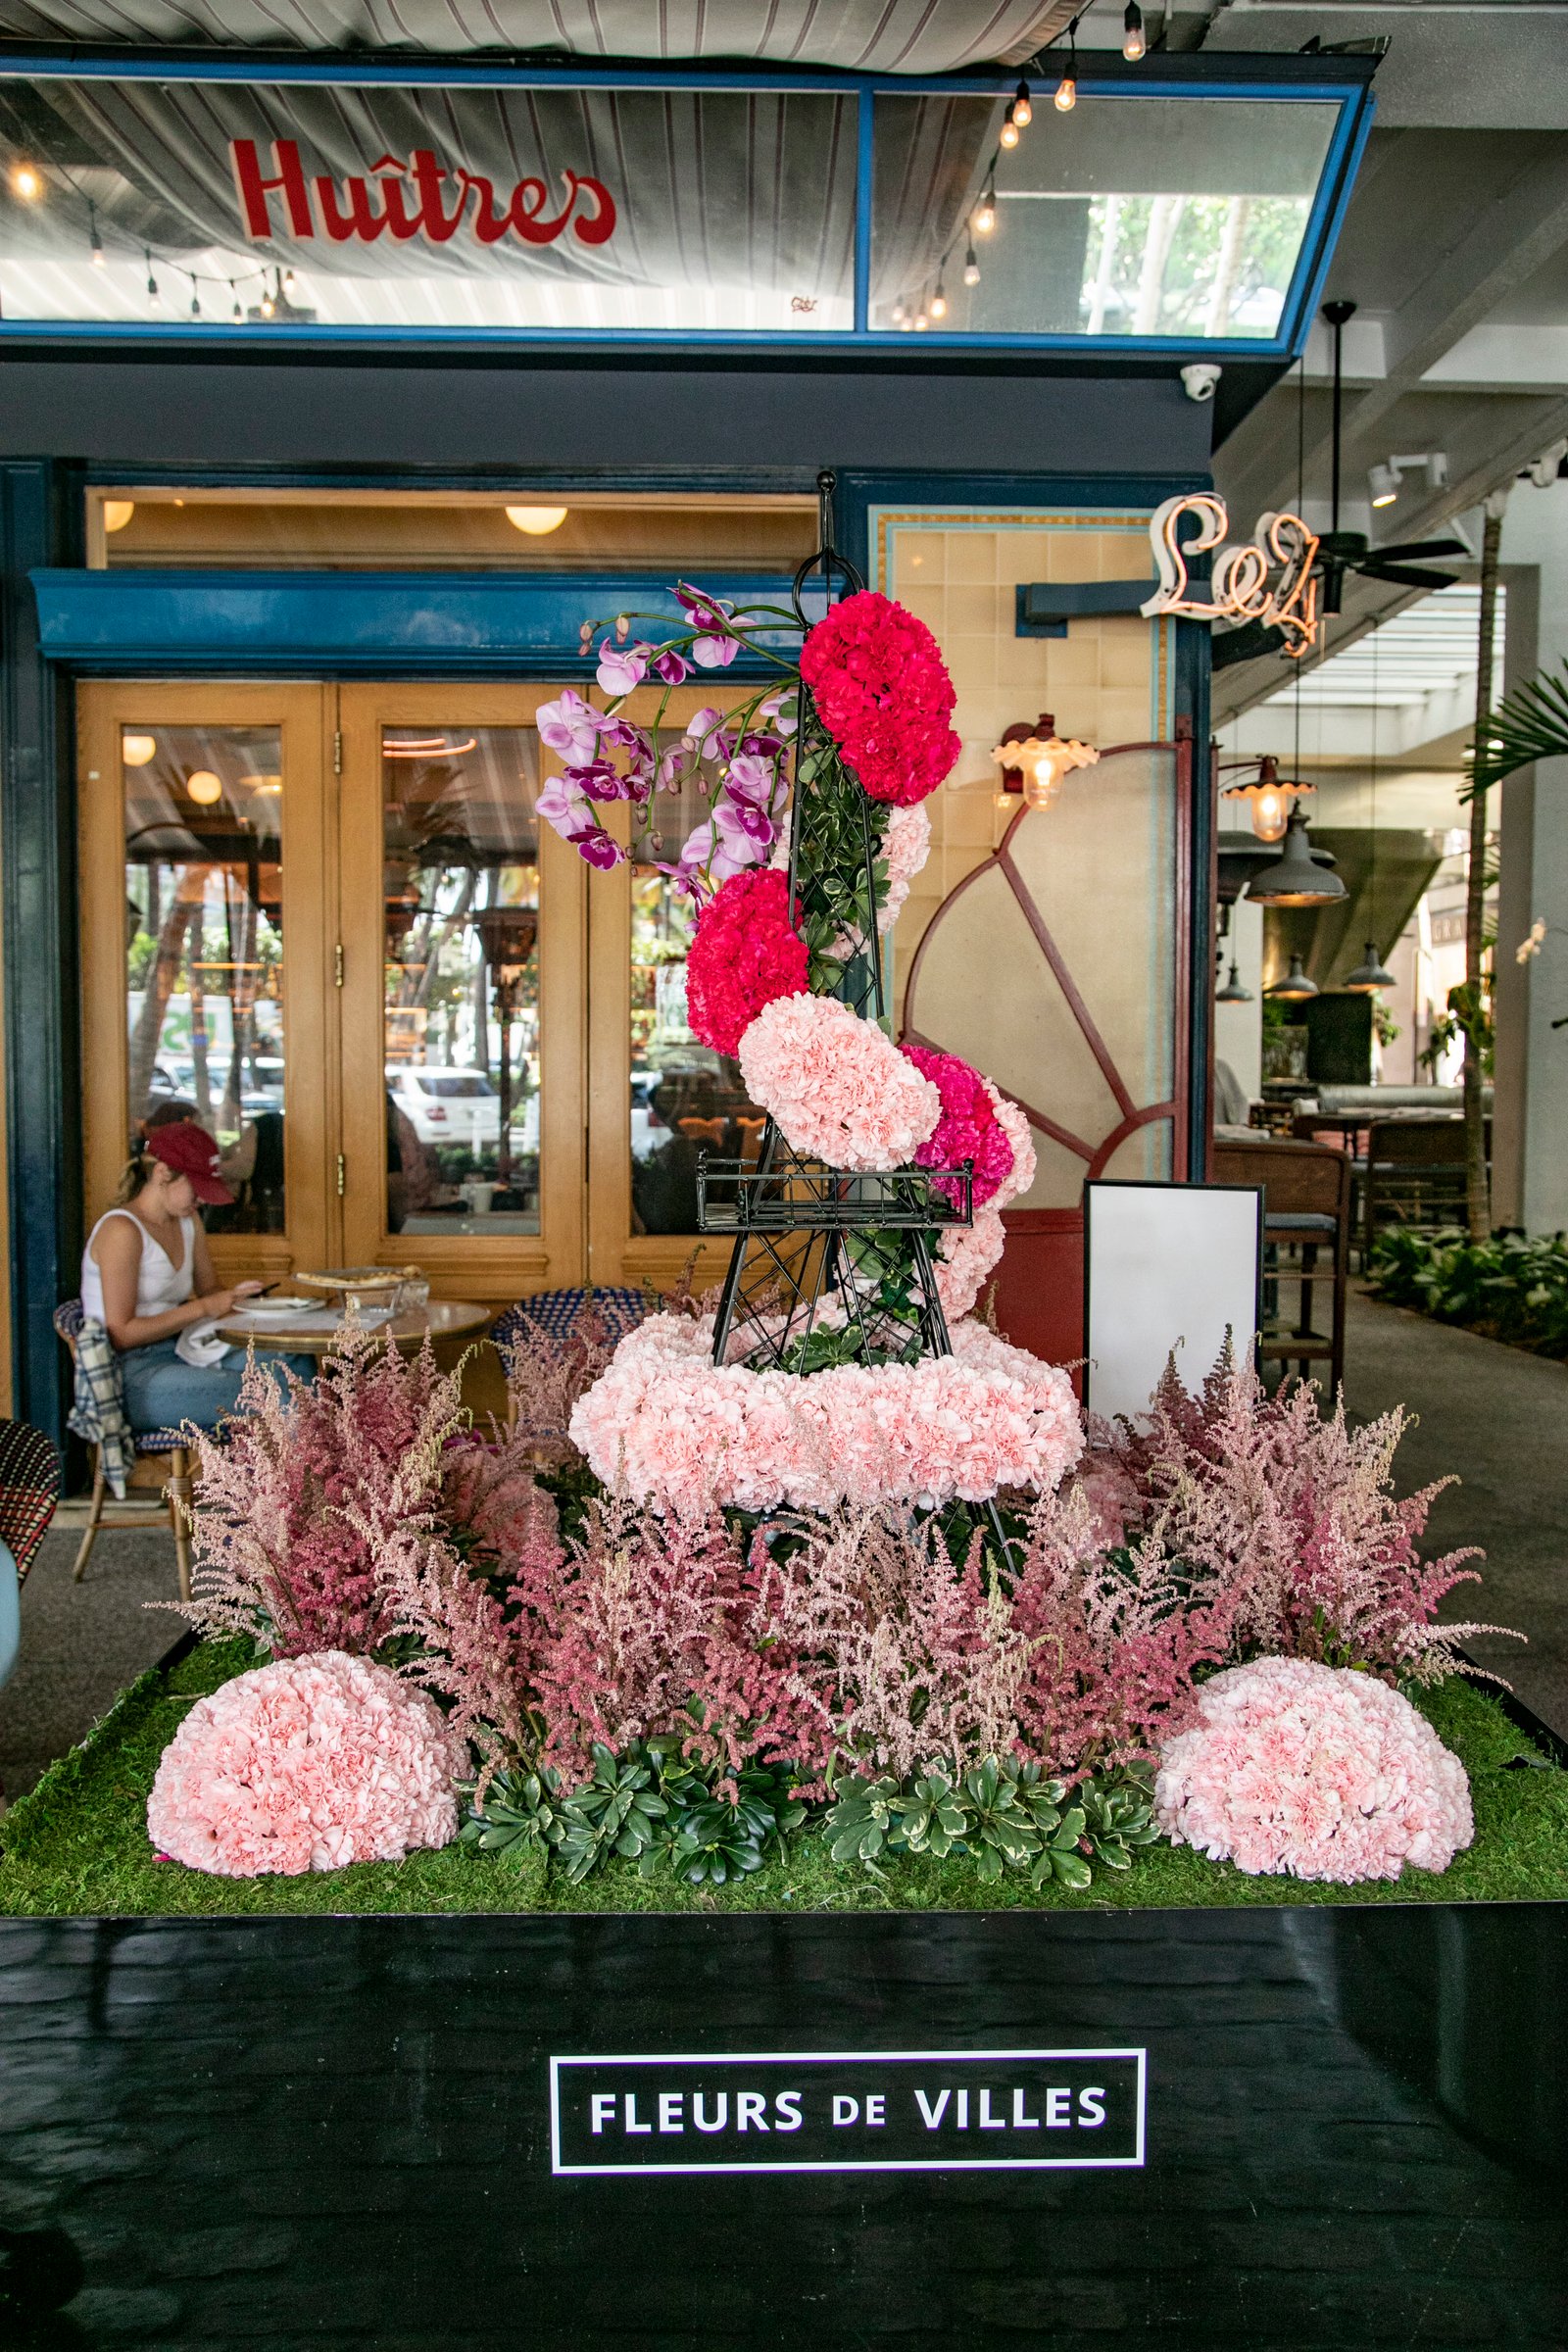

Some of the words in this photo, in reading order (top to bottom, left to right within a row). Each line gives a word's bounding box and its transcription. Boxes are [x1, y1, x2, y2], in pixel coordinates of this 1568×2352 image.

[228, 140, 616, 248] Huîtres
[591, 2091, 804, 2133] FLEURS
[831, 2095, 887, 2127] DE
[914, 2087, 1107, 2130] VILLES
